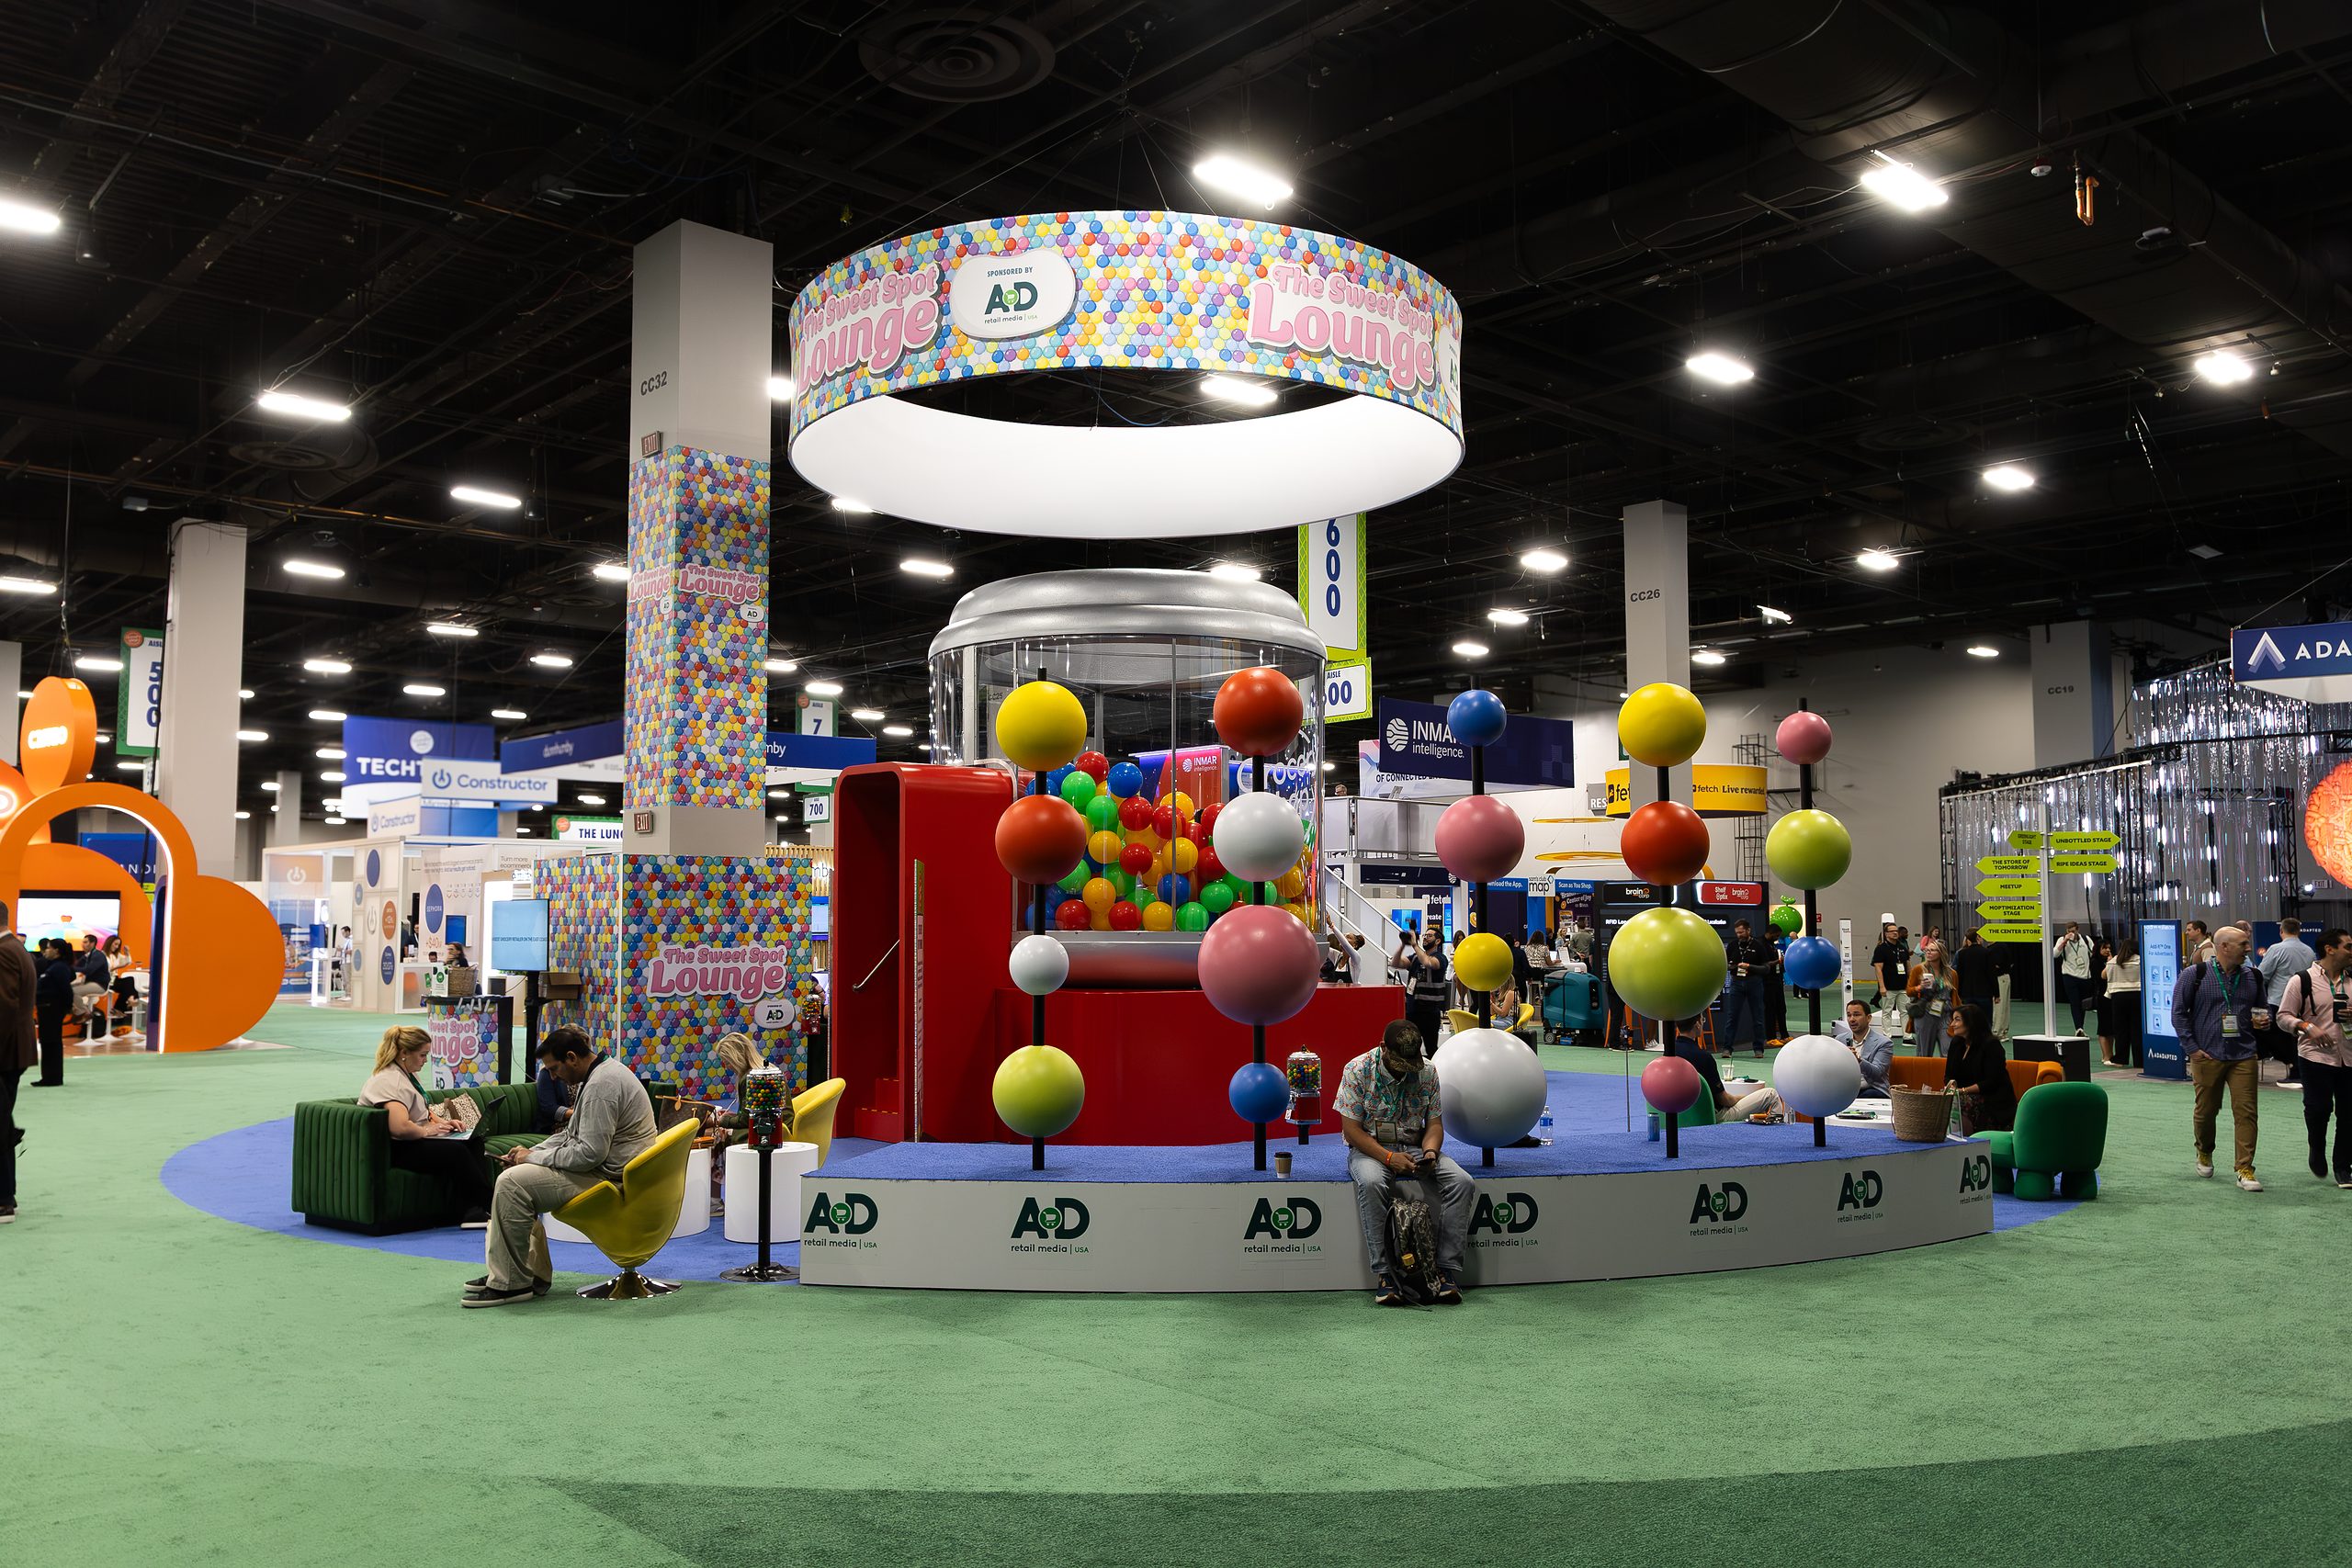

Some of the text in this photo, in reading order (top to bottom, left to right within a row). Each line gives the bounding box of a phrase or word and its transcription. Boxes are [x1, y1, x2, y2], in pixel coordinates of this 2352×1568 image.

[987, 266, 1034, 277] SPONSORED BY
[803, 267, 937, 338] The Sweet Spot
[1272, 265, 1433, 337] The Sweet Spot
[984, 316, 1001, 324] retail
[1002, 314, 1023, 322] media
[1250, 282, 1434, 387] Lounge
[798, 299, 936, 394] Lounge
[640, 371, 668, 396] CC32
[1326, 519, 1341, 617] 600
[687, 565, 760, 585] The Sweet Spot
[630, 575, 670, 601] Lounge
[680, 570, 759, 604] Lounge
[1630, 588, 1661, 603] CC26
[1327, 670, 1341, 679] AISLE
[1324, 681, 1352, 705] 00
[2047, 686, 2075, 694] CC19
[812, 718, 822, 735] 7
[1412, 720, 1457, 744] INMA
[1194, 755, 1217, 765] INMAR
[457, 773, 548, 792] Constructor
[1376, 773, 1385, 783] OF
[1697, 784, 1719, 793] fetch
[1722, 784, 1739, 794] Live
[808, 803, 823, 816] 700
[379, 811, 416, 829] Constructor
[579, 828, 596, 839] THE
[1529, 882, 1550, 896] map
[1625, 887, 1644, 896] brain
[1732, 887, 1745, 896] brain
[1430, 894, 1448, 905] fet
[663, 947, 785, 968] The Sweet Spot
[650, 960, 784, 1000] Lounge
[449, 1020, 476, 1035] Spot
[1960, 1195, 1972, 1205] retail
[1973, 1194, 1984, 1203] media
[1838, 1214, 1852, 1224] retail
[1854, 1212, 1872, 1222] media
[1690, 1227, 1709, 1236] retail
[1710, 1226, 1733, 1235] media
[804, 1238, 827, 1247] retail
[829, 1239, 857, 1248] media
[1011, 1244, 1035, 1252] retail
[1037, 1244, 1068, 1253] media
[1244, 1244, 1269, 1253] retail
[1272, 1244, 1300, 1253] media
[1467, 1239, 1490, 1248] retail
[1492, 1238, 1520, 1247] media
